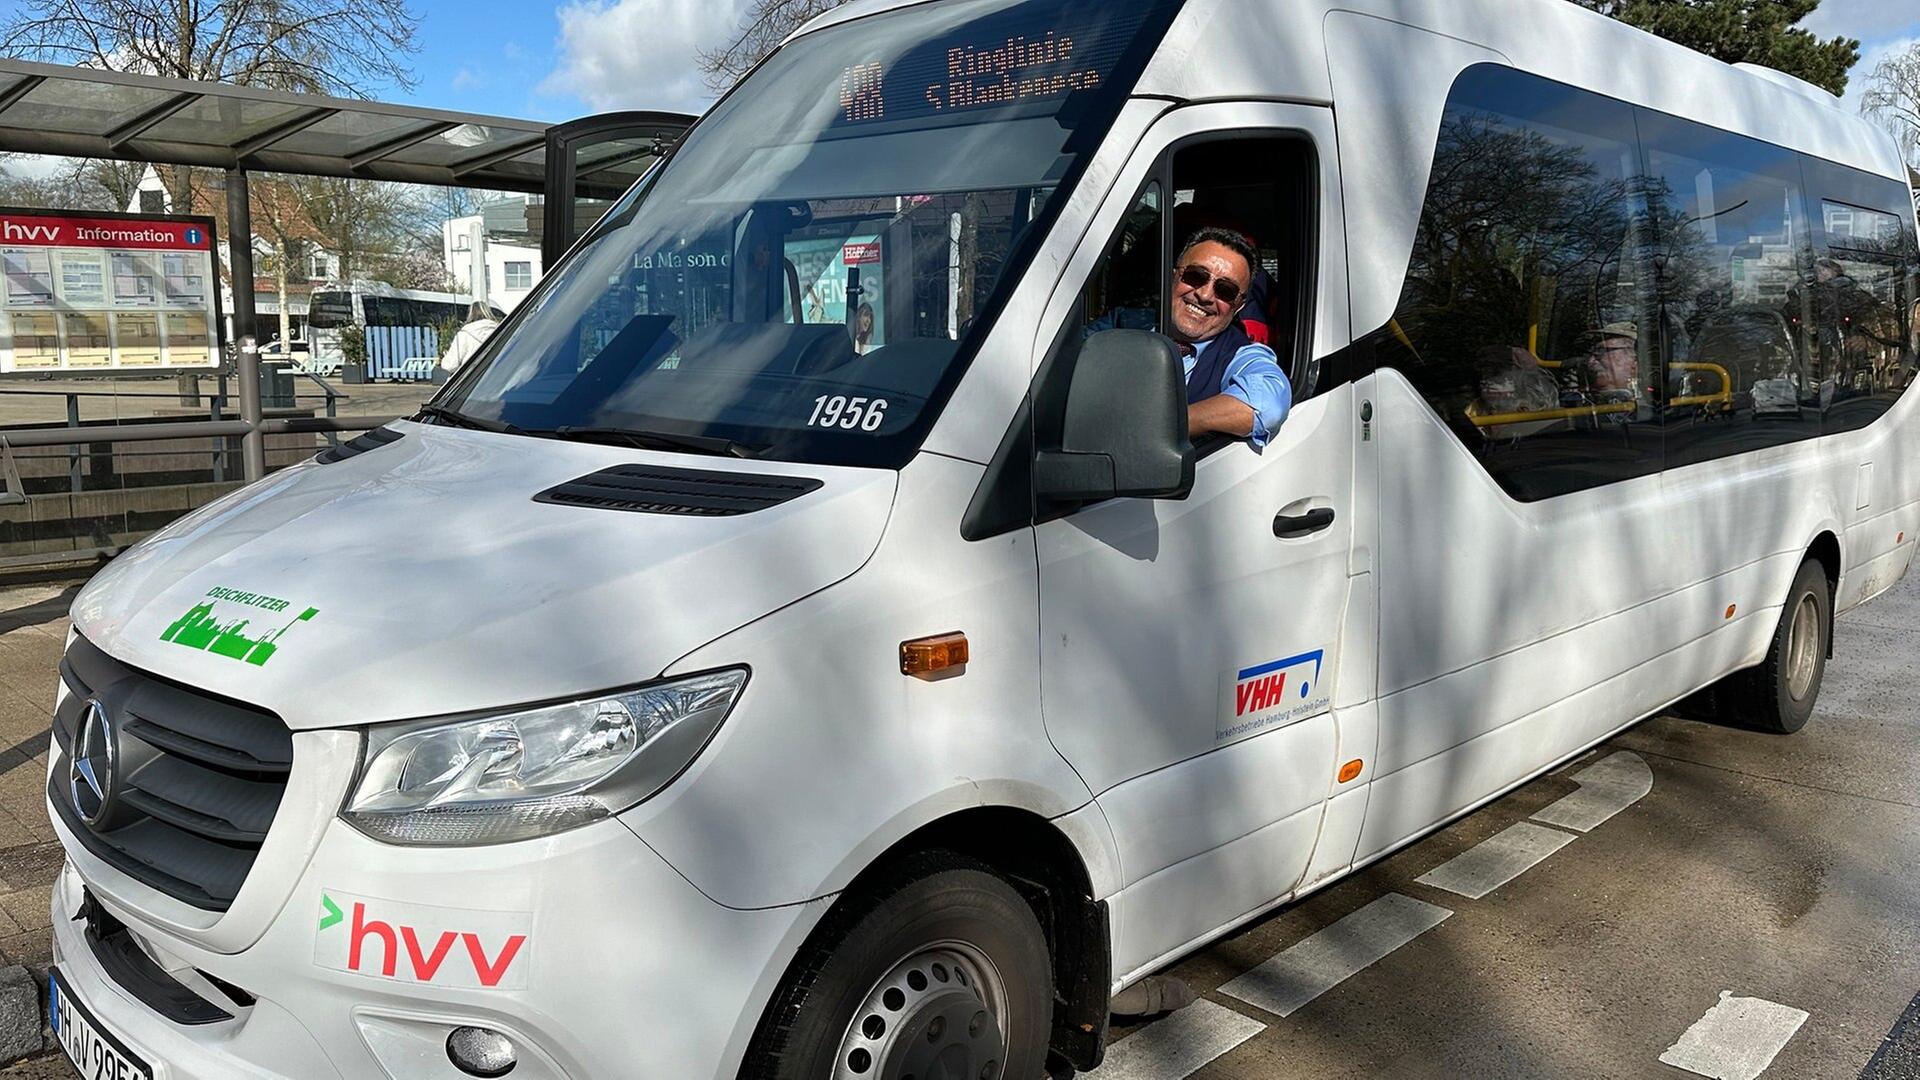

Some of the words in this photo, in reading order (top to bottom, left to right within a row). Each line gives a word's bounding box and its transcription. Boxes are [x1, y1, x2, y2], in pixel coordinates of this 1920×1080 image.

[948, 31, 1073, 78] Ringlinie
[3, 220, 60, 241] hvv
[76, 227, 175, 243] Information
[634, 253, 653, 269] La
[657, 251, 717, 268] Mason
[807, 394, 888, 432] 1956
[206, 586, 291, 612] DEICHFLITZER
[1236, 672, 1286, 717] VHH
[94, 1038, 140, 1080] 995
